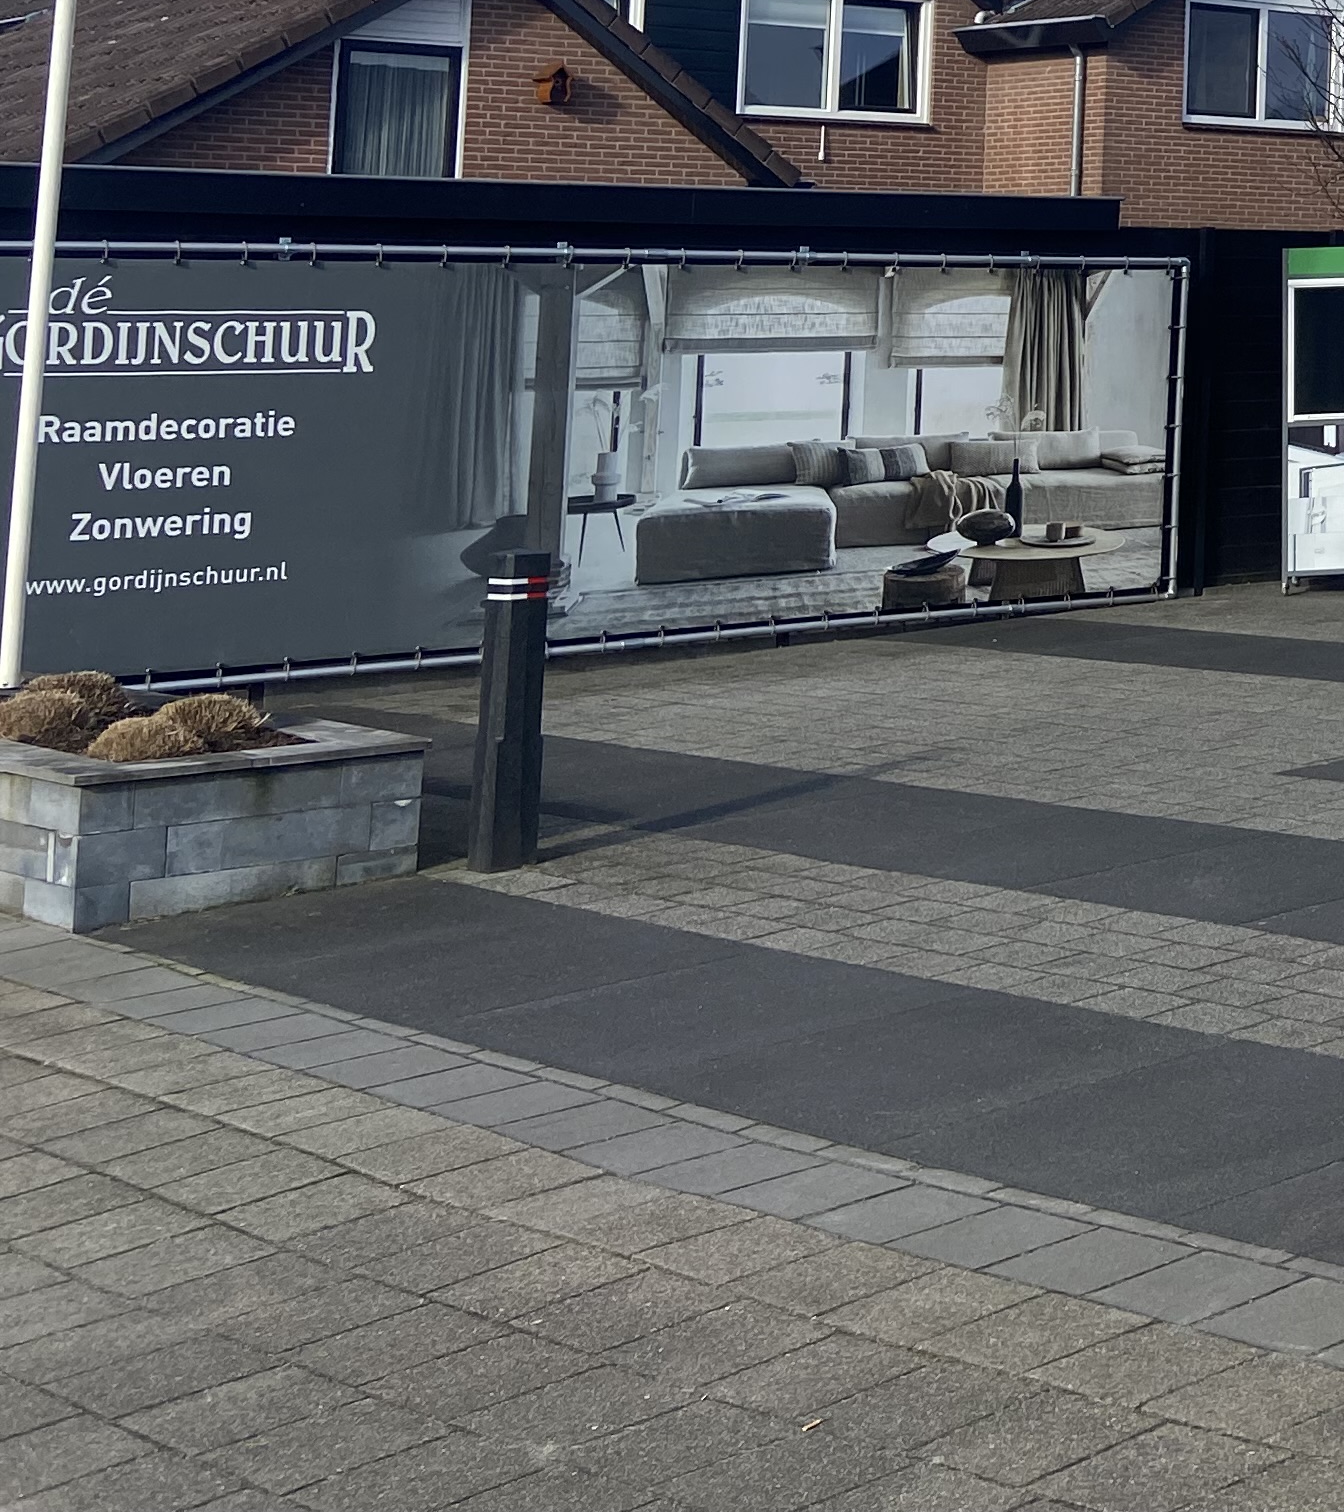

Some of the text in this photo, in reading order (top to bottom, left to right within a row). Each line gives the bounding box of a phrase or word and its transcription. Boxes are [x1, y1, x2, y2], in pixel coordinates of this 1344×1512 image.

[48, 275, 113, 315] dé
[0, 310, 377, 373] ORDIJNSCHUUR
[37, 410, 296, 443] Raamdecoratie
[99, 463, 231, 490] Vloeren
[69, 508, 252, 541] Zonwering
[26, 561, 288, 597] www.gordijnschuur.nl
